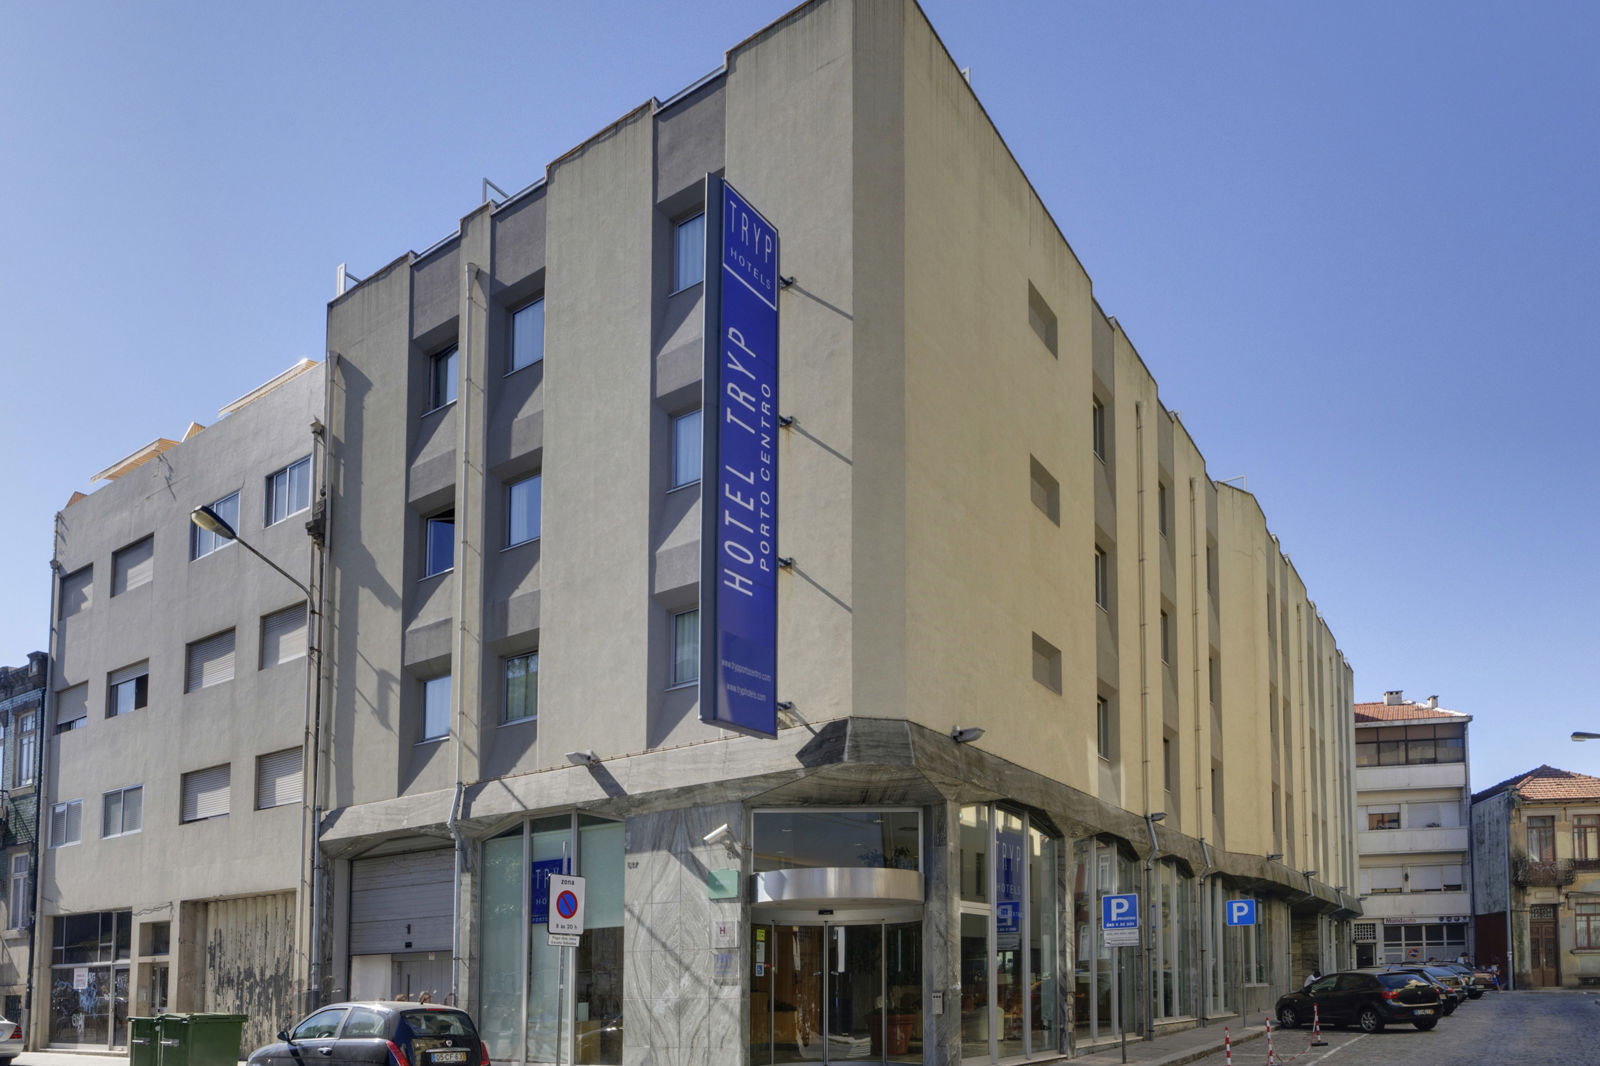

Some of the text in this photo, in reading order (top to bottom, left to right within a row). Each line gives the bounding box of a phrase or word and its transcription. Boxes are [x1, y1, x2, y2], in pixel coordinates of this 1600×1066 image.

[729, 200, 772, 264] TRYP
[730, 247, 772, 290] HOTELS
[723, 326, 757, 597] HOTEL TRYP
[760, 383, 772, 573] PORTO CENTRO
[1111, 898, 1129, 922] P
[1232, 902, 1249, 924] P
